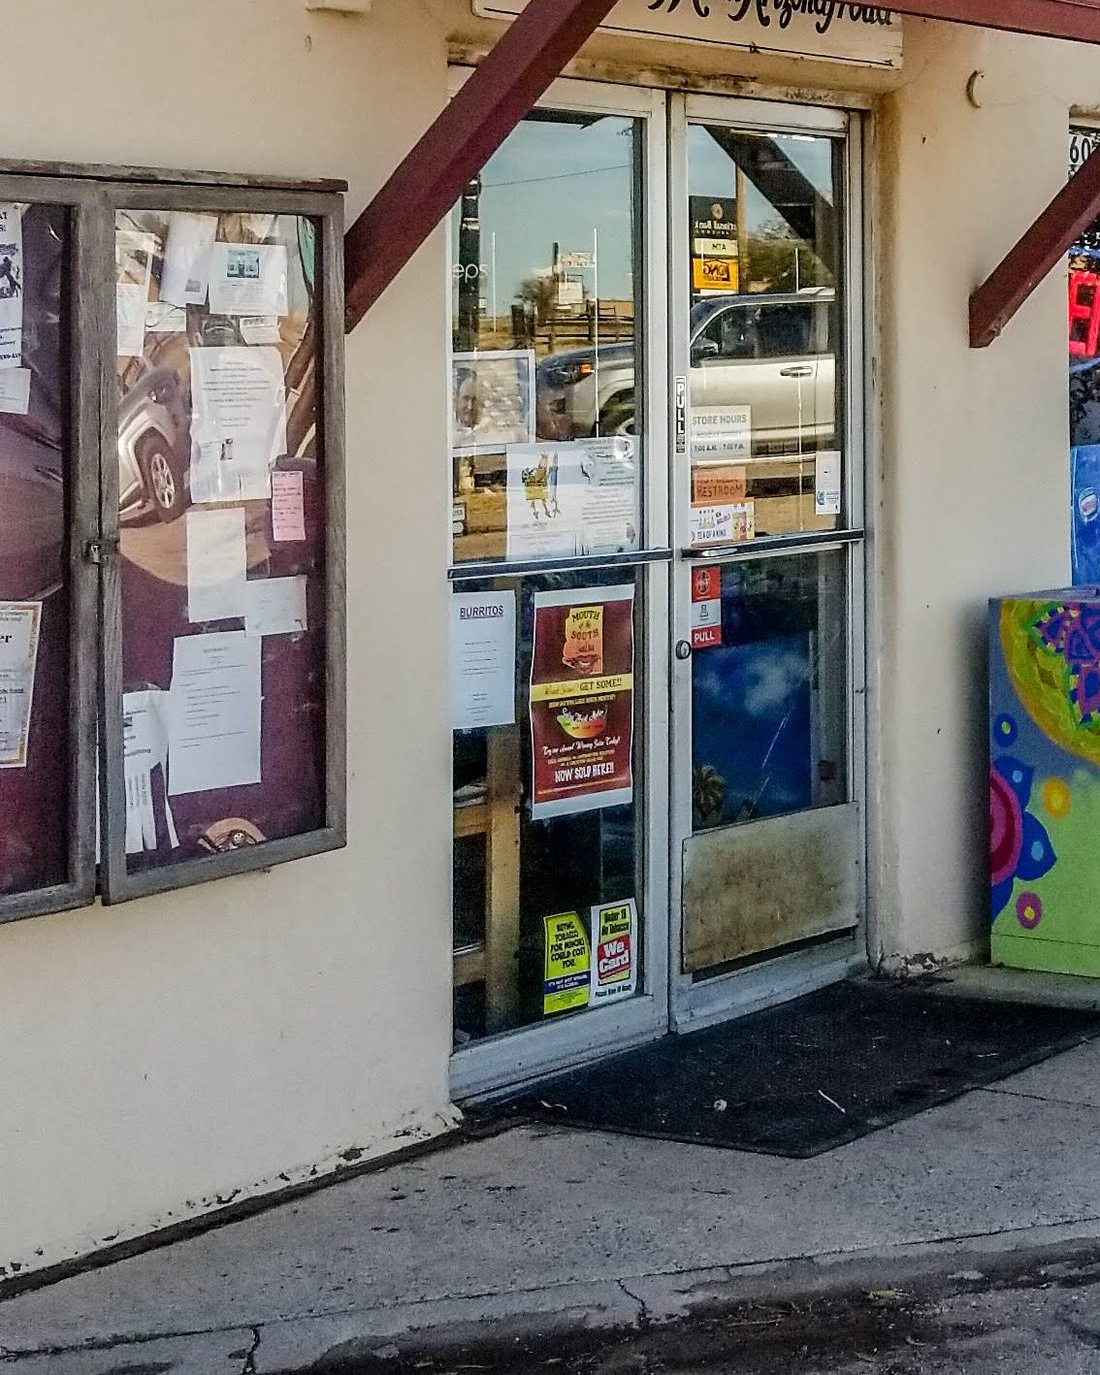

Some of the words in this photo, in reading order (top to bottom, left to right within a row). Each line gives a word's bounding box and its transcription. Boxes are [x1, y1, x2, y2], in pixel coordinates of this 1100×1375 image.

[676, 382, 686, 434] PULL
[692, 415, 718, 426] STORE
[720, 414, 747, 424] HOURS
[696, 483, 744, 498] RESTROOM
[460, 606, 504, 618] BURRITOS
[571, 610, 601, 623] MOUTH
[570, 629, 599, 640] SOUTH
[694, 630, 715, 643] PULL
[554, 768, 574, 783] NOW
[574, 766, 591, 779] SOLD
[551, 951, 572, 962] COULD
[571, 947, 586, 958] COST
[603, 940, 625, 958] We
[599, 950, 630, 973] Card
